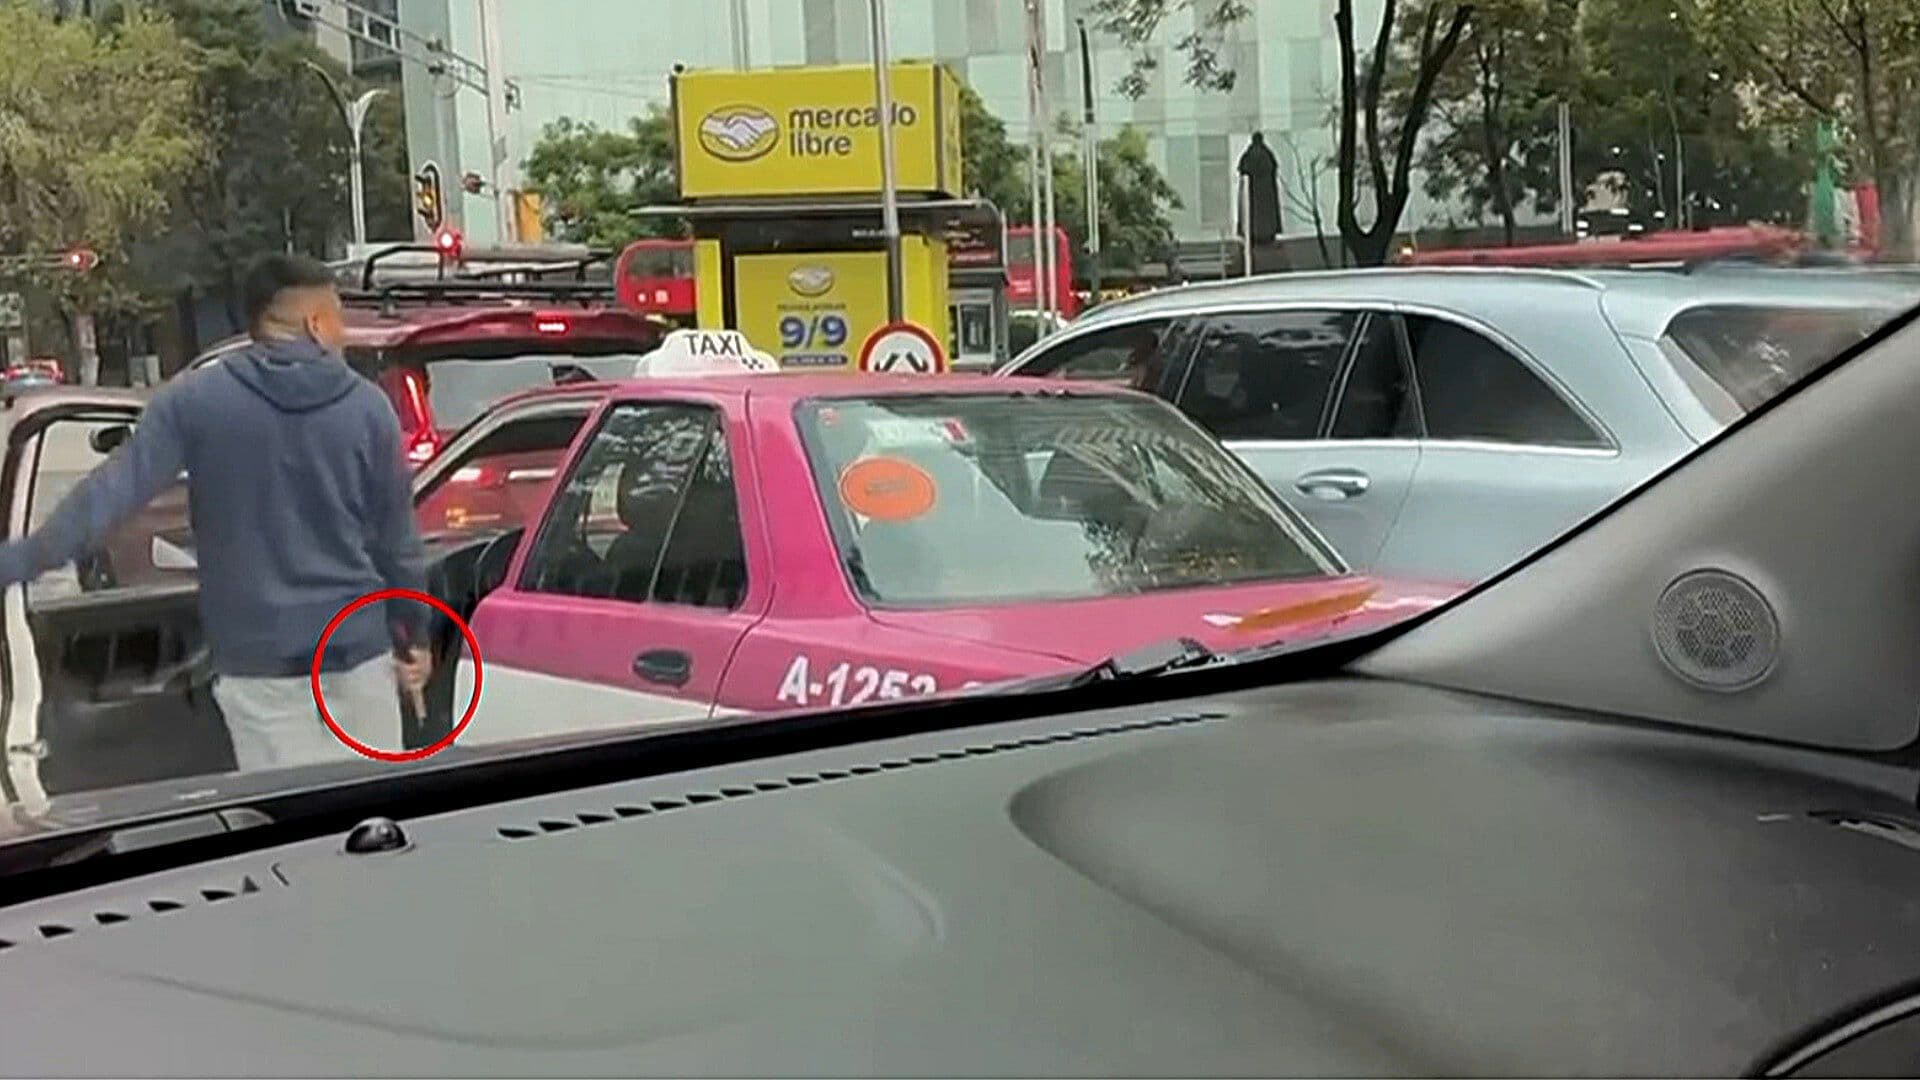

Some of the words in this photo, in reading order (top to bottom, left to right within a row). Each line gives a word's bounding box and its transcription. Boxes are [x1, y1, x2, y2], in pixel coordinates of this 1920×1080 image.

[790, 132, 851, 156] libre
[780, 315, 847, 347] 9/9
[683, 334, 742, 356] TAXI
